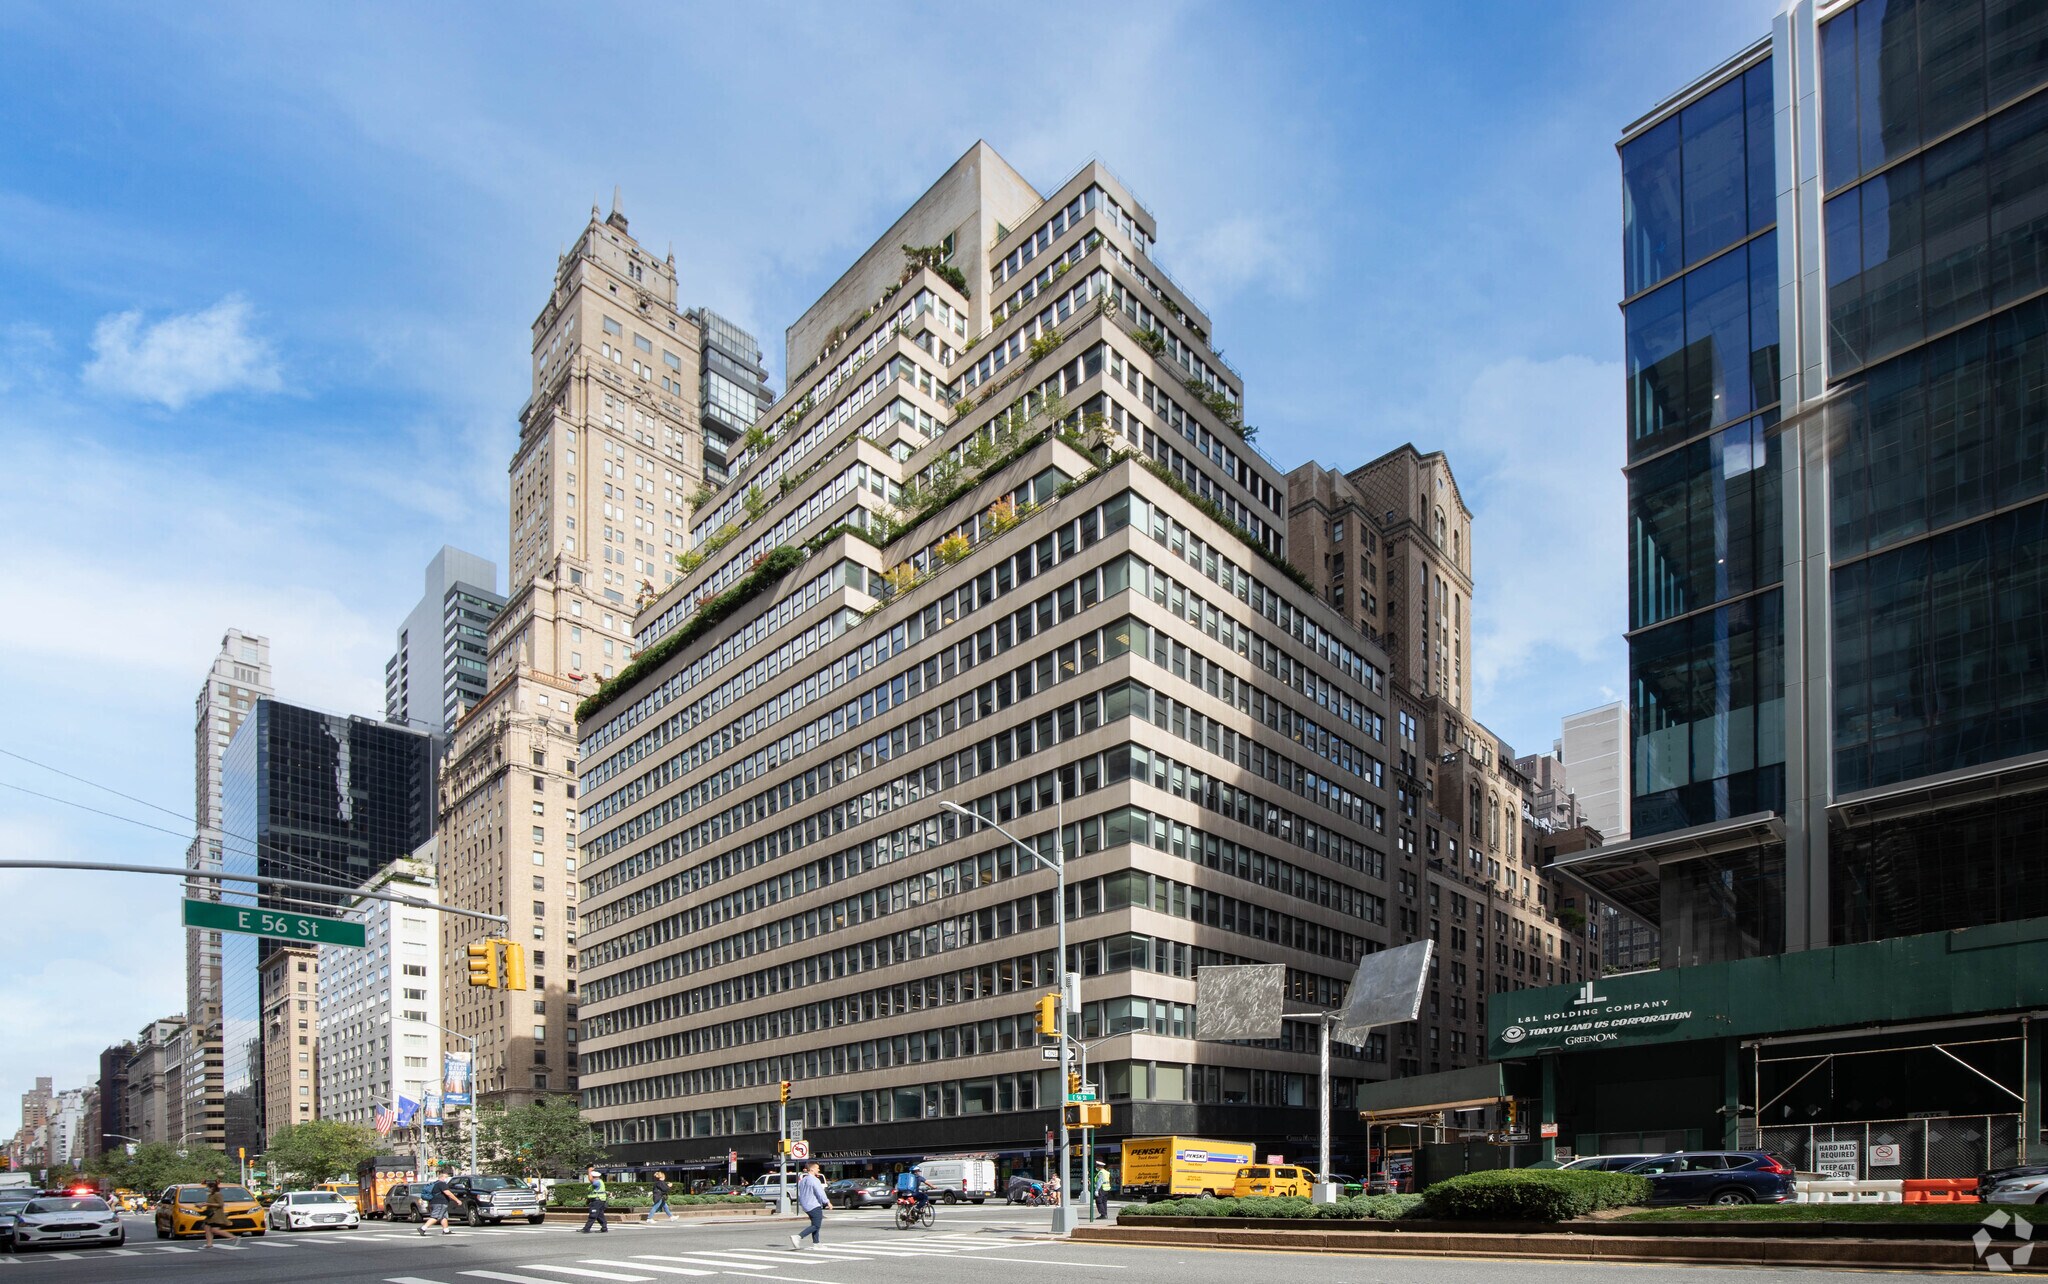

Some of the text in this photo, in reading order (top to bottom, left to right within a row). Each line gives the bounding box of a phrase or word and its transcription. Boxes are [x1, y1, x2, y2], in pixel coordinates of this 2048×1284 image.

[238, 911, 319, 938] E 56 St
[1518, 1000, 1669, 1024] L&L HOLDING COMPANY
[1529, 1011, 1692, 1036] TOKYU LAND US CORPORATION
[1839, 1143, 1857, 1151] HATS
[1130, 1147, 1168, 1156] PENSKE
[1820, 1151, 1855, 1159] REQUIRED
[1390, 1164, 1413, 1172] edEx
[1838, 1163, 1855, 1171] GATE
